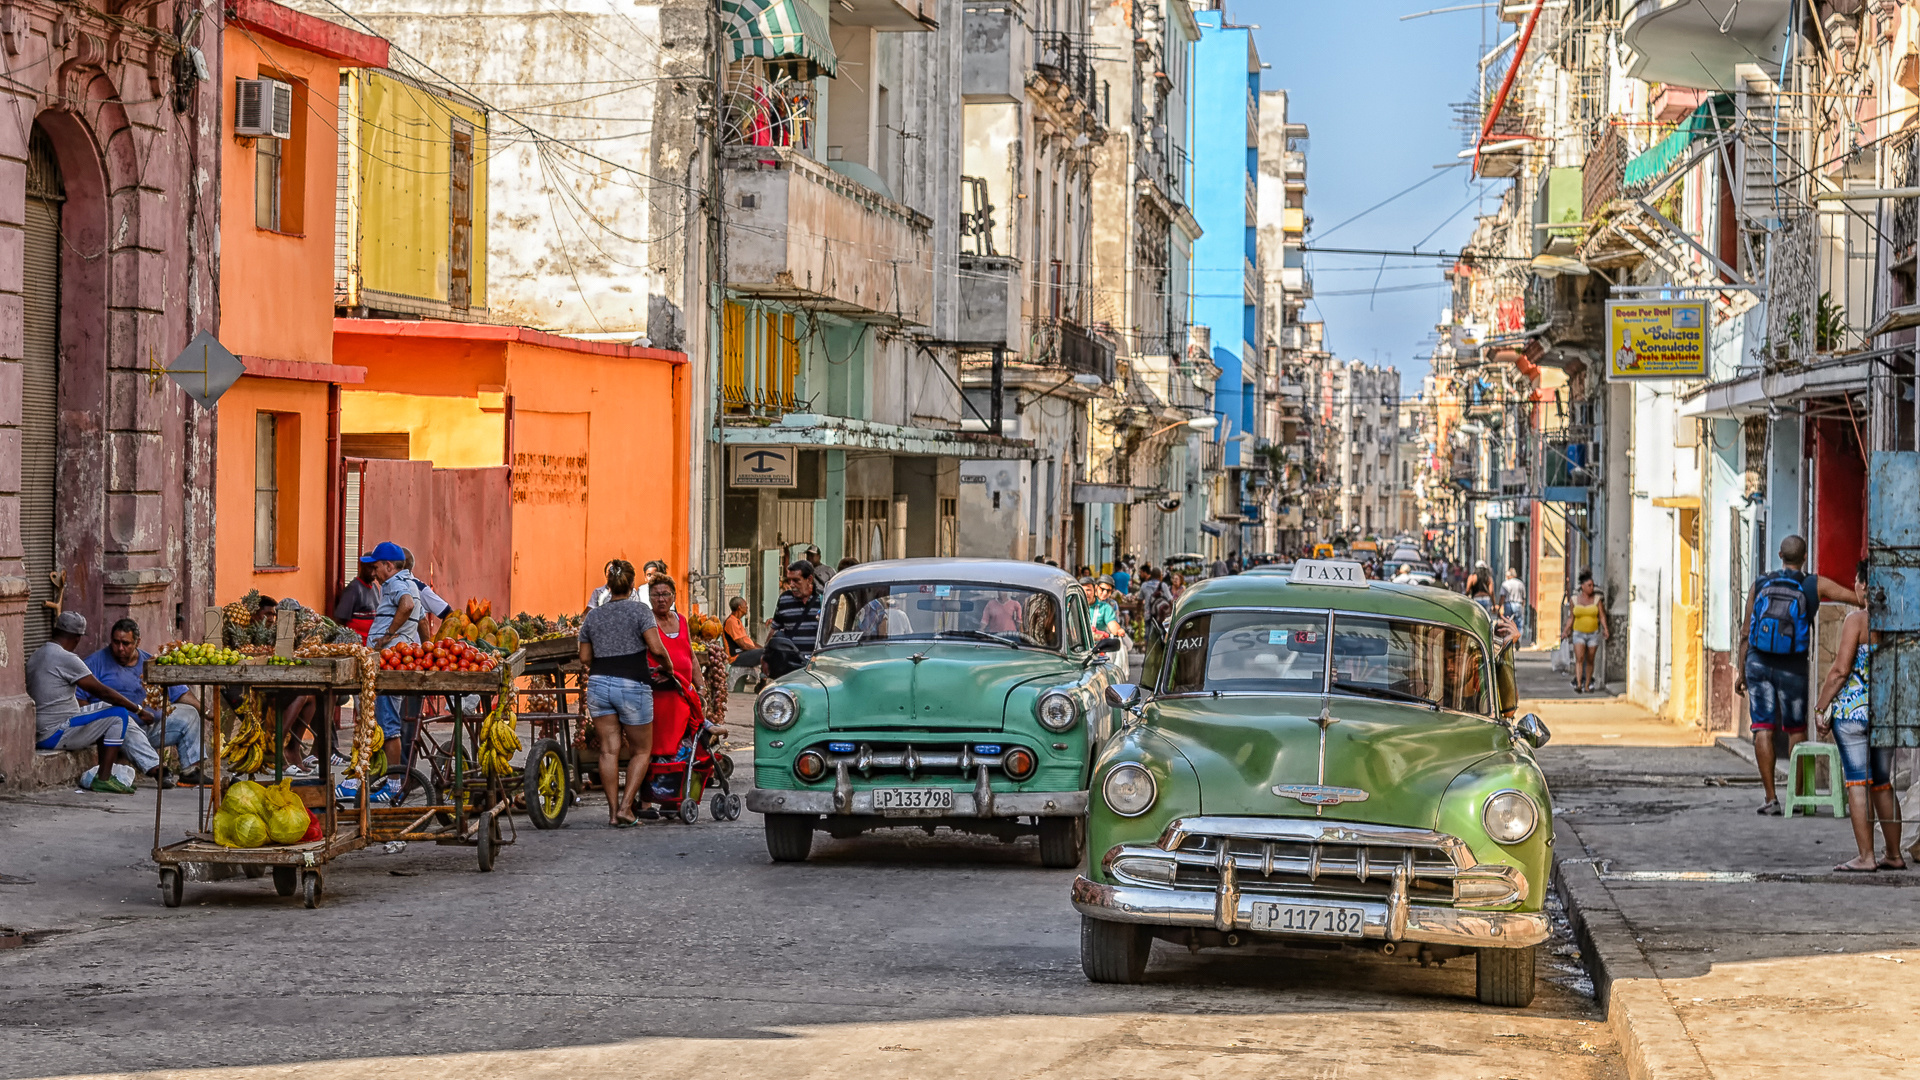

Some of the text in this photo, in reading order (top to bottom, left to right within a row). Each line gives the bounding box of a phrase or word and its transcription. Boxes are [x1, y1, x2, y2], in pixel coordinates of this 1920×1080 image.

[1653, 329, 1700, 340] Delicias
[1640, 341, 1699, 353] Consulado
[1305, 565, 1354, 581] TAXI
[831, 633, 861, 641] TAXI
[1176, 637, 1203, 650] TAXI
